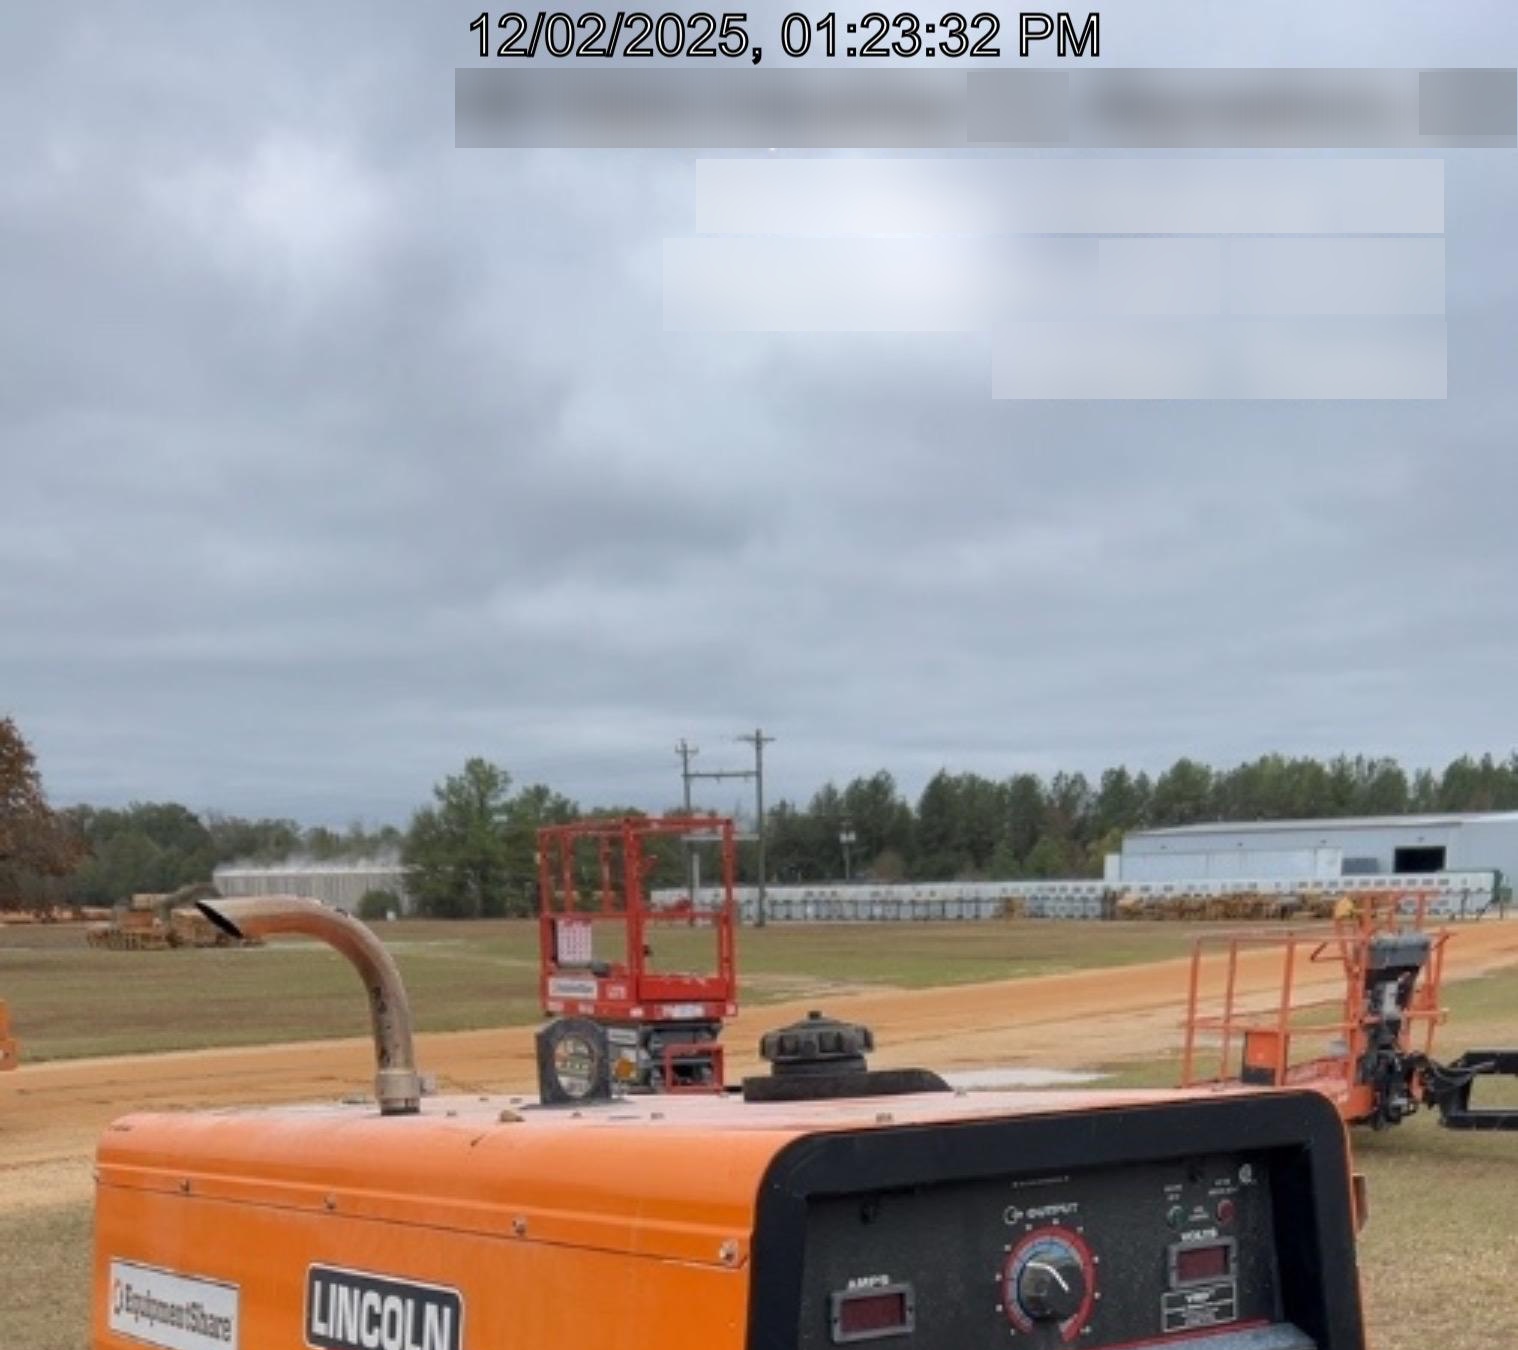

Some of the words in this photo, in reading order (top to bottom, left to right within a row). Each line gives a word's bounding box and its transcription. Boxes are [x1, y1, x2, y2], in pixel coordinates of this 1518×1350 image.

[1026, 1203, 1079, 1219] OUTPUT
[848, 1274, 889, 1289] AMPS
[126, 1283, 232, 1343] EquipmentShare
